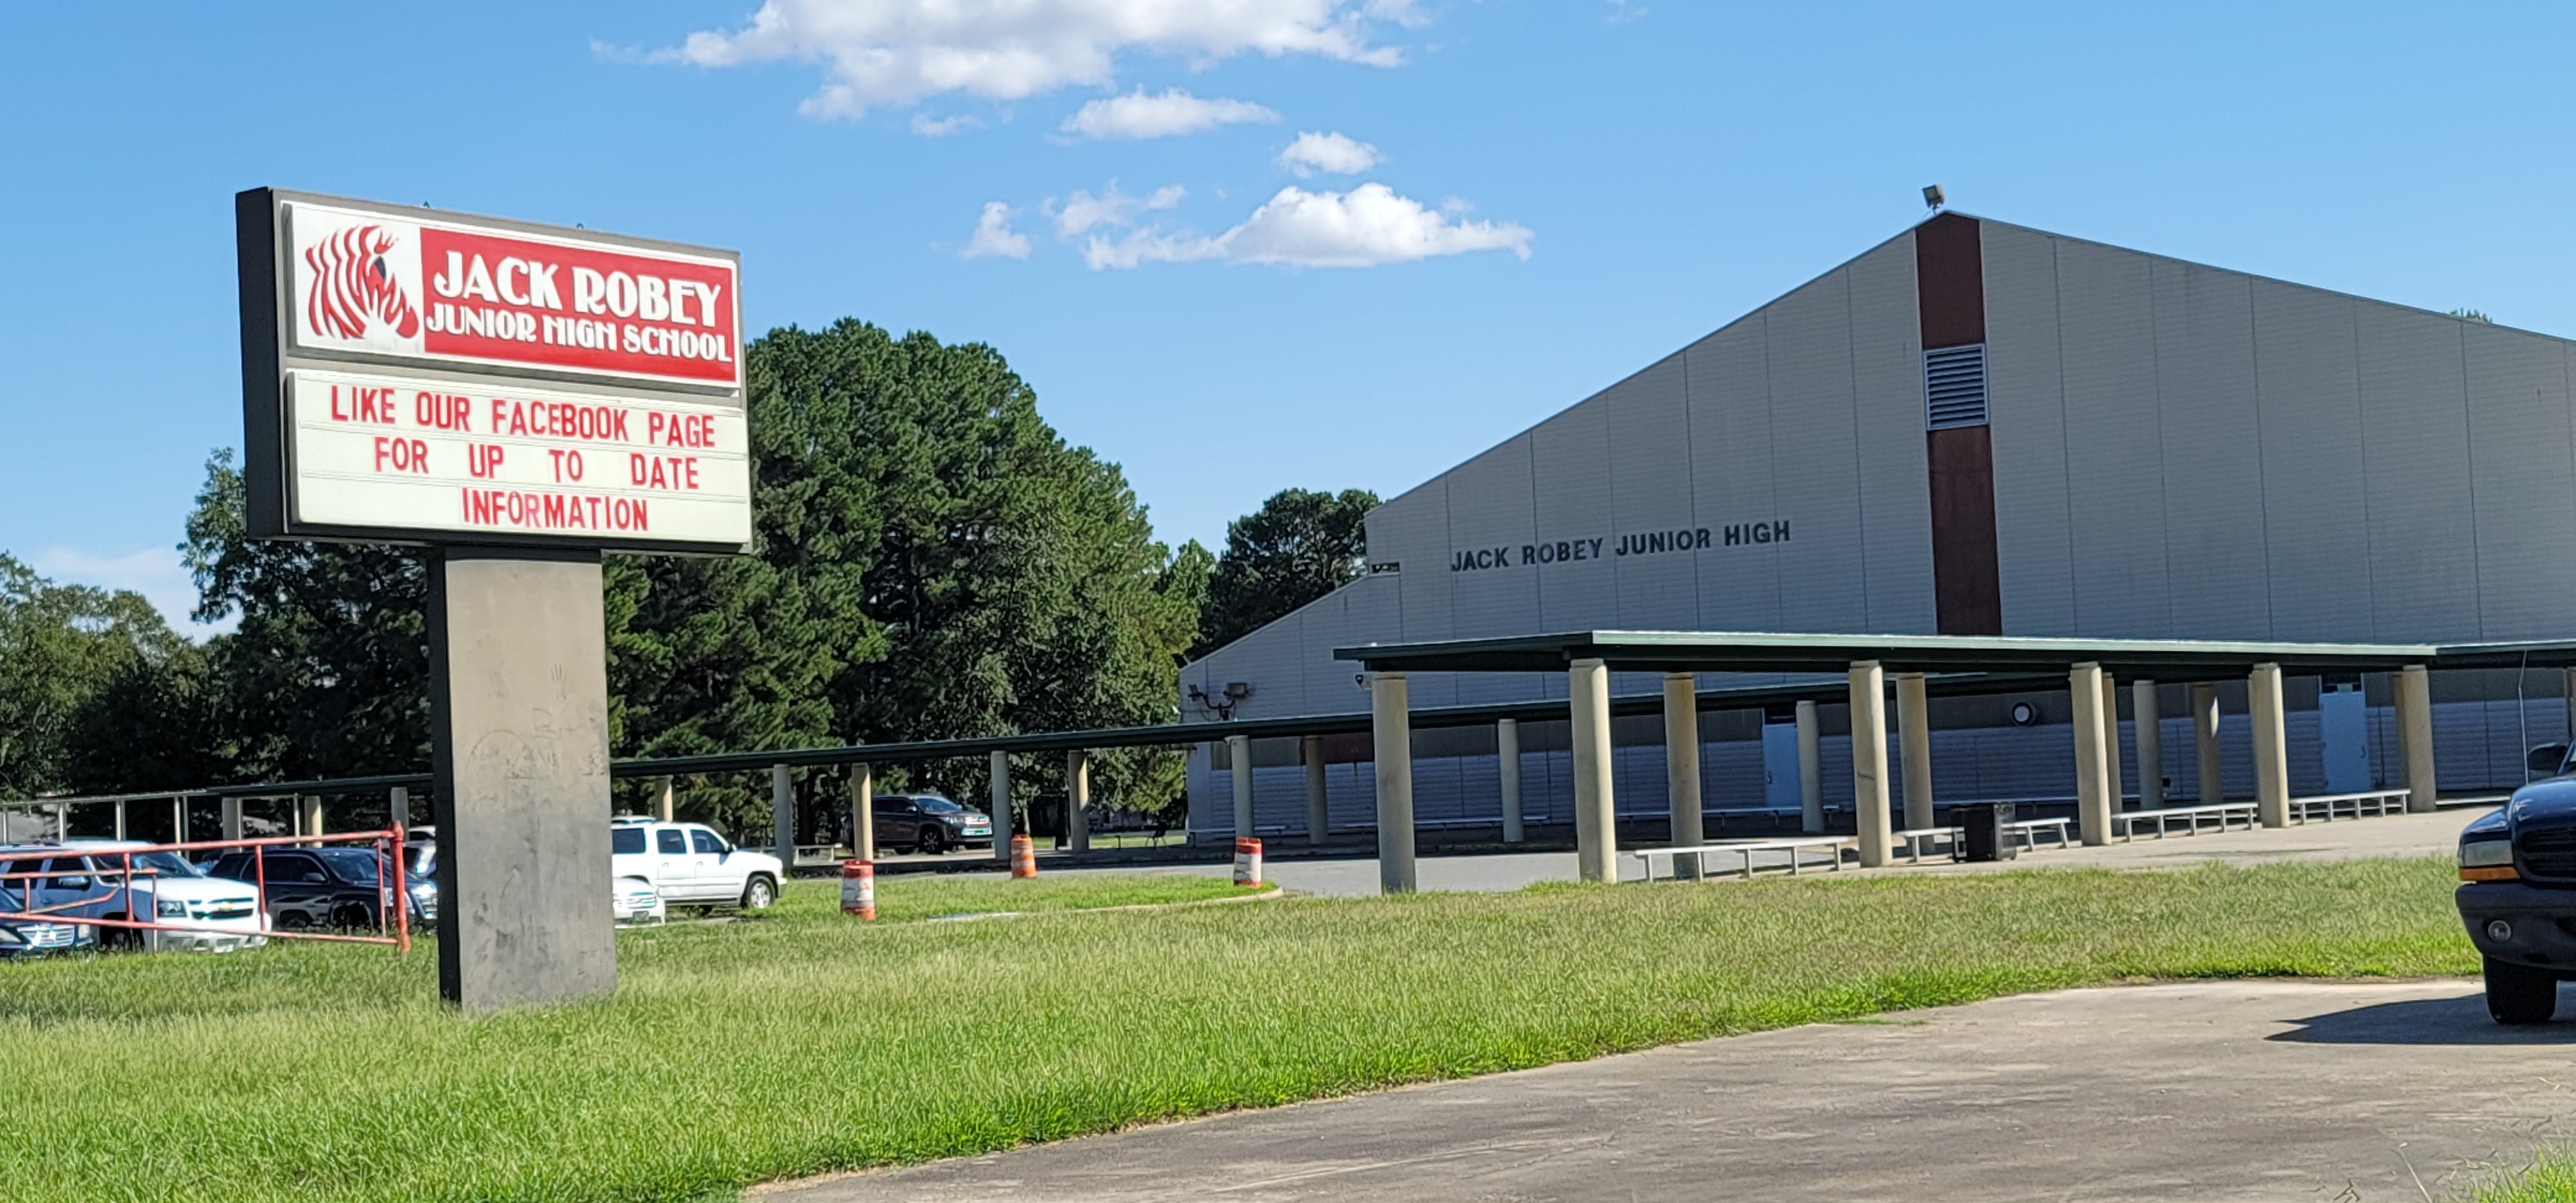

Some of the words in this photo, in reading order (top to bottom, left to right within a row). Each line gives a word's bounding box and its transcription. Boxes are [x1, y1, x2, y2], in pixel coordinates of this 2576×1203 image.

[433, 250, 563, 311] JACK
[572, 267, 721, 328] ROBEY
[425, 303, 537, 343] JUNIOR
[542, 315, 618, 351] HIGH
[622, 325, 733, 363] SCHOOL
[331, 385, 395, 424] LIKE
[415, 390, 471, 431] OUR
[491, 399, 629, 441] FACEBOOK
[648, 411, 715, 448] PAGE
[374, 436, 428, 473] FOR
[468, 443, 504, 478] UP
[548, 448, 583, 482] TO
[630, 452, 699, 489] DATE
[462, 488, 649, 531] INFORMATION
[1450, 546, 1510, 572] JACK
[1522, 537, 1604, 565] ROBEY
[1615, 527, 1711, 556] JUNIOR
[1724, 520, 1790, 547] HIGH
